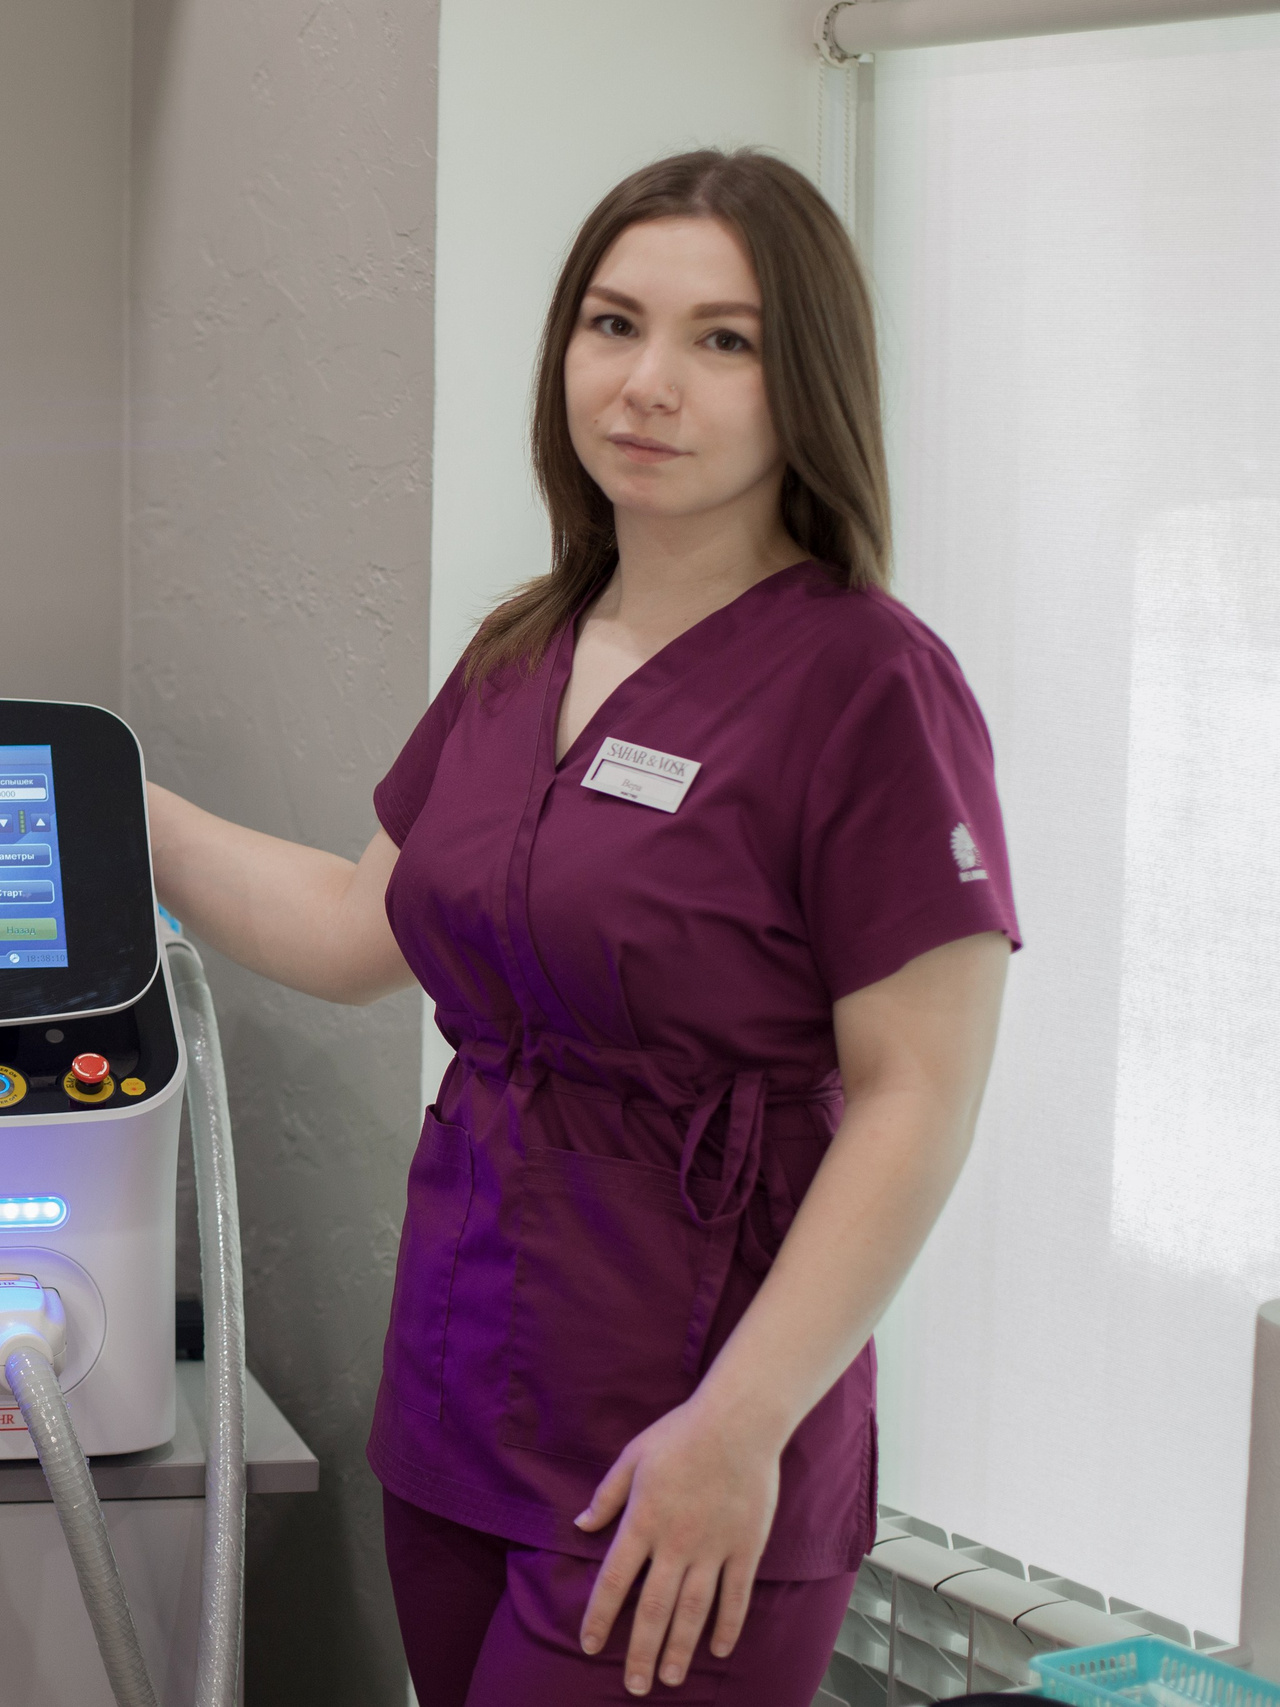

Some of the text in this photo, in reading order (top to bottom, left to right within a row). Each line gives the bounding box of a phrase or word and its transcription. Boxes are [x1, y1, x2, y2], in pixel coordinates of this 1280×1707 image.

[607, 742, 689, 777] SAHAR & VOSK
[6, 926, 37, 936] Назад
